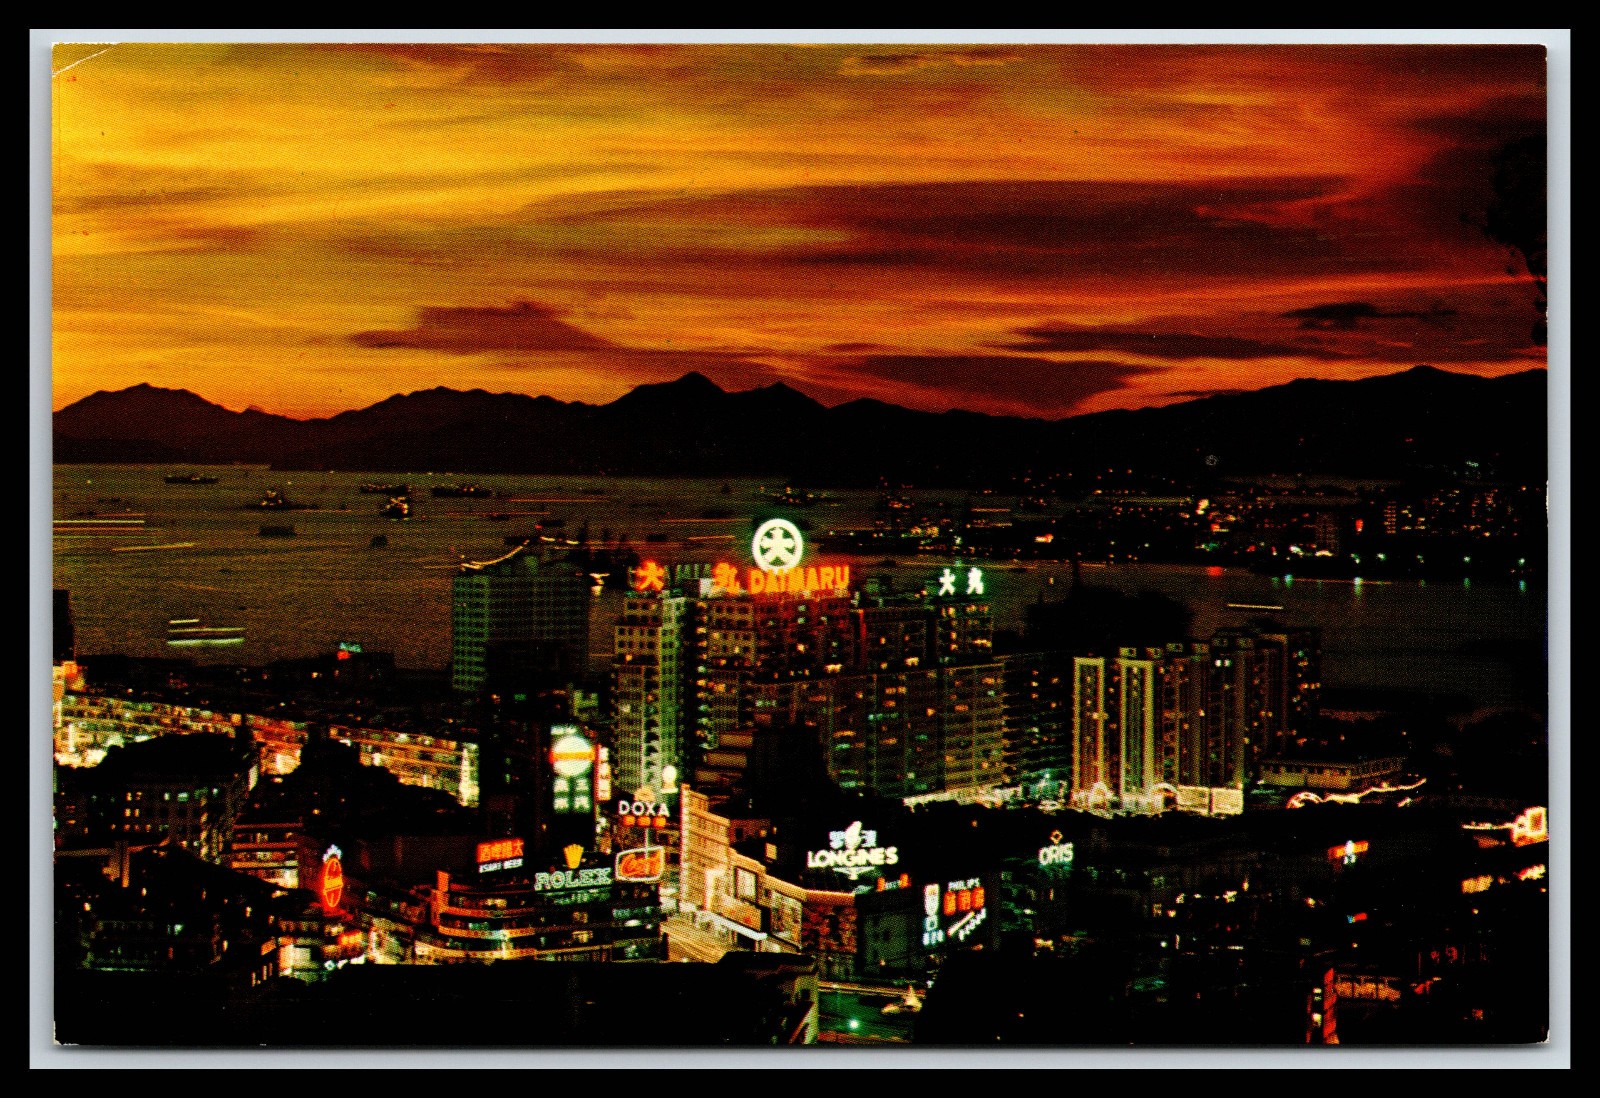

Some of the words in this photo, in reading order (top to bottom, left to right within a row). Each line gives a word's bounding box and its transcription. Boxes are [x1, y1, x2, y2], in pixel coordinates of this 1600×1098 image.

[748, 566, 849, 594] DAIMARU
[618, 800, 670, 817] DOXA
[807, 846, 899, 868] LONGINES
[1038, 842, 1073, 865] ORIS
[534, 868, 613, 891] ROLEX
